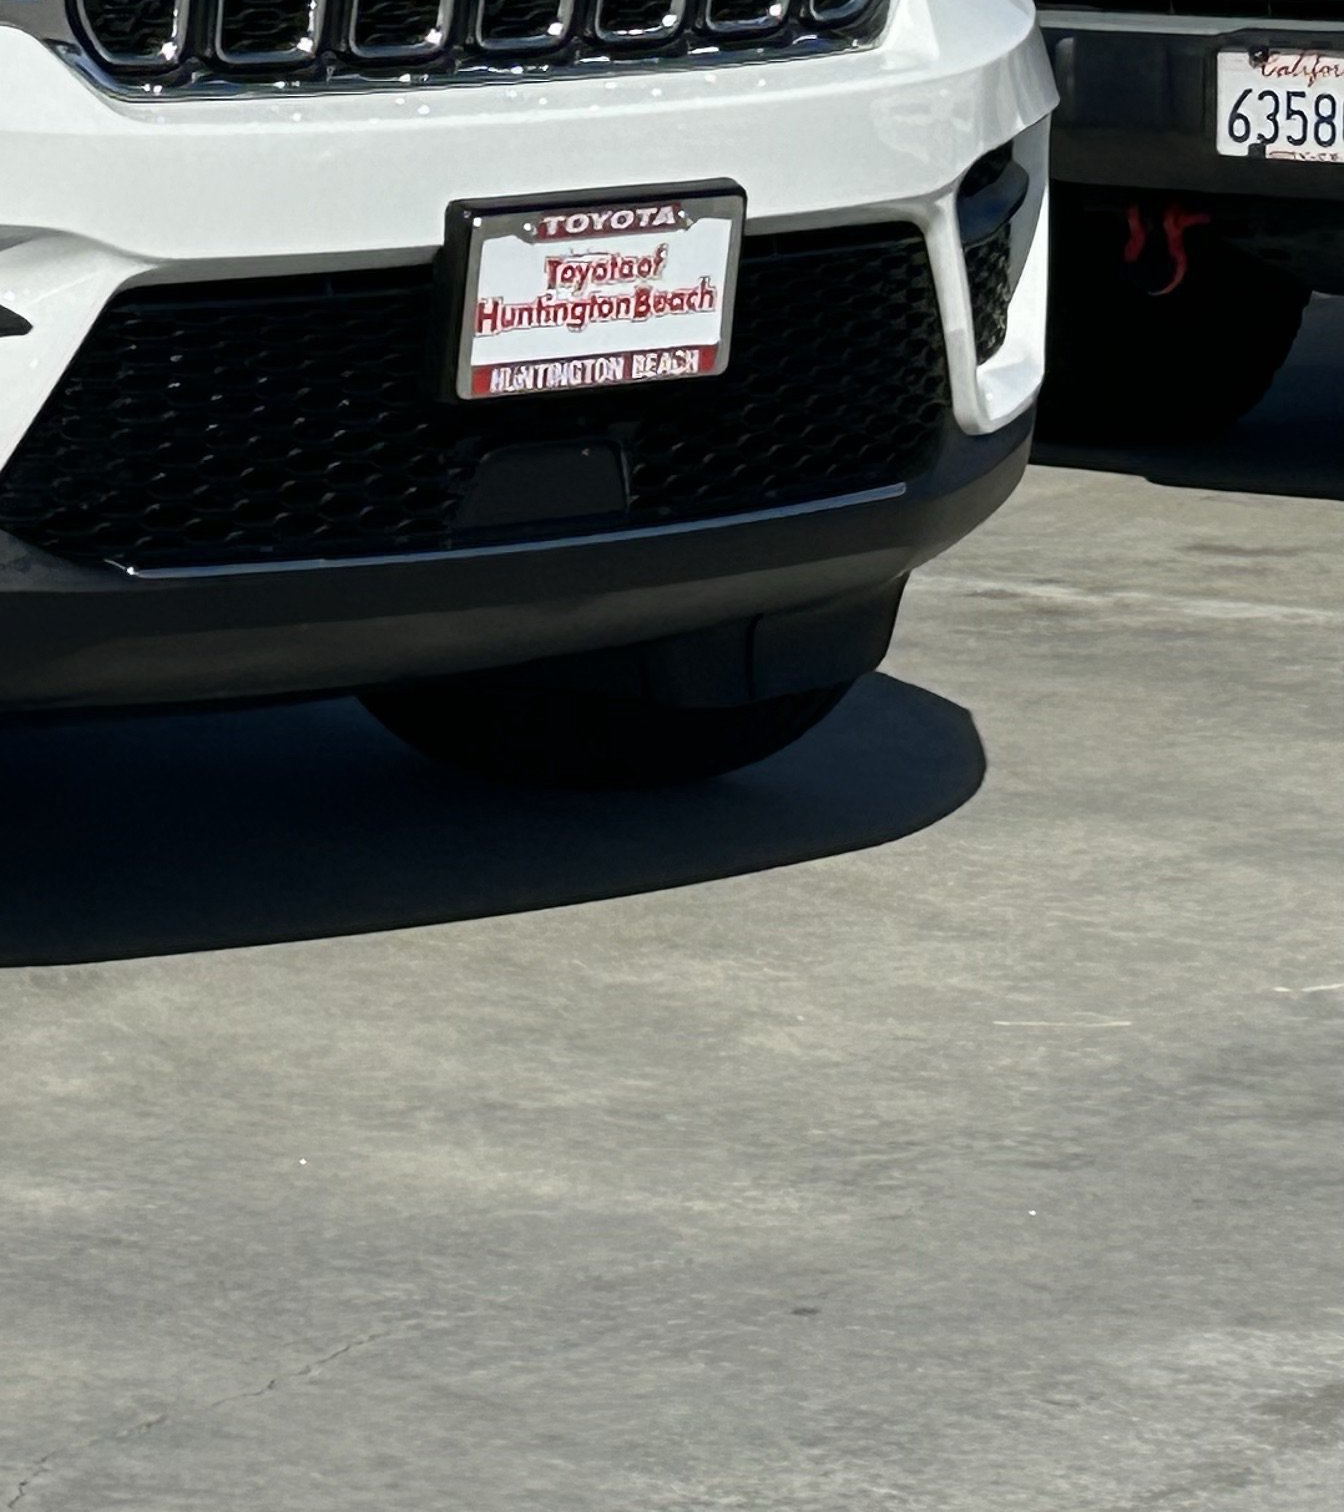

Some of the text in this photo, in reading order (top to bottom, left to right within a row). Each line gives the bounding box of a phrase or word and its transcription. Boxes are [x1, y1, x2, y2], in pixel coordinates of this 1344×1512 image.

[1228, 88, 1344, 147] 6358
[541, 205, 677, 235] TOYOTA
[489, 349, 700, 393] HUNTINGTON BEACH
